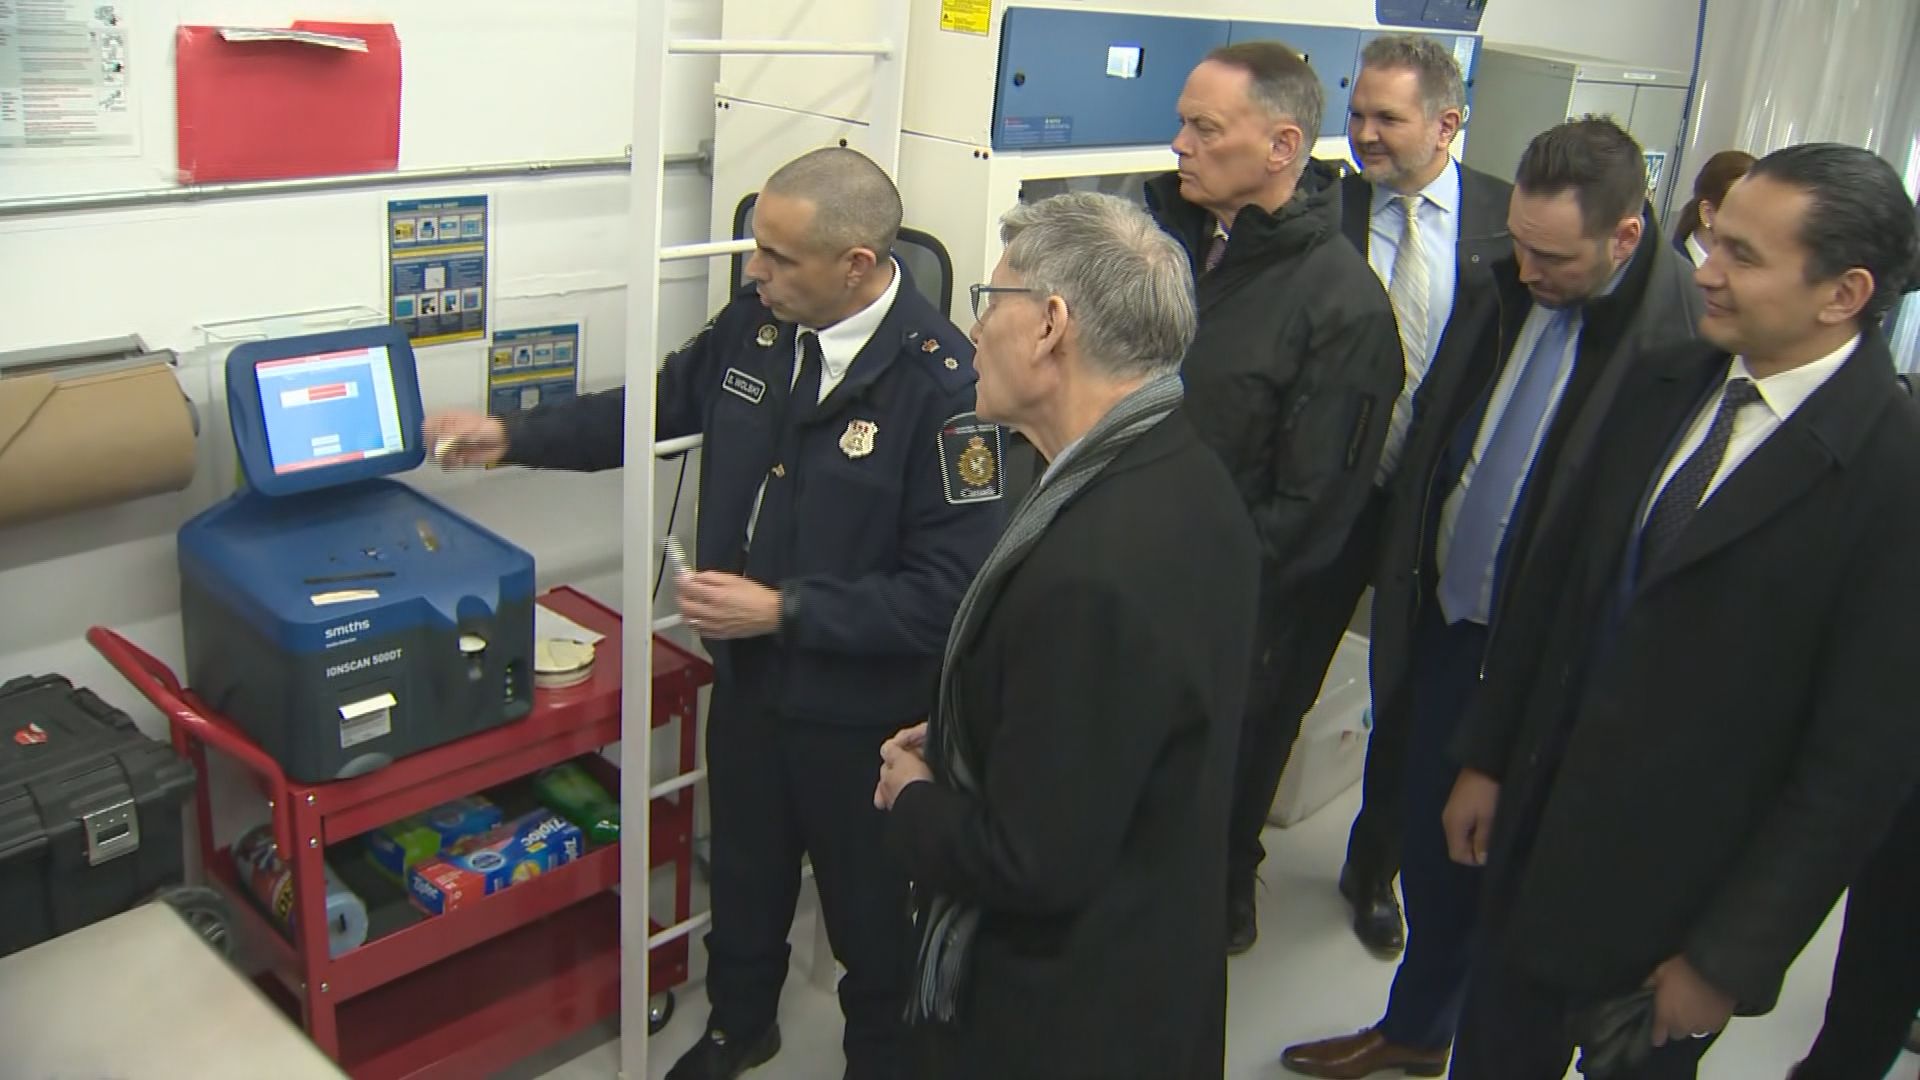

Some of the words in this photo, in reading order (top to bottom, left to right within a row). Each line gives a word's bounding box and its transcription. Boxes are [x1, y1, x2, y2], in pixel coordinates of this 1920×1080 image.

[960, 485, 996, 497] Canada
[325, 619, 371, 638] smiths
[326, 657, 371, 679] IONSCAN
[372, 648, 403, 666] 500DT
[521, 817, 567, 848] Ziploc
